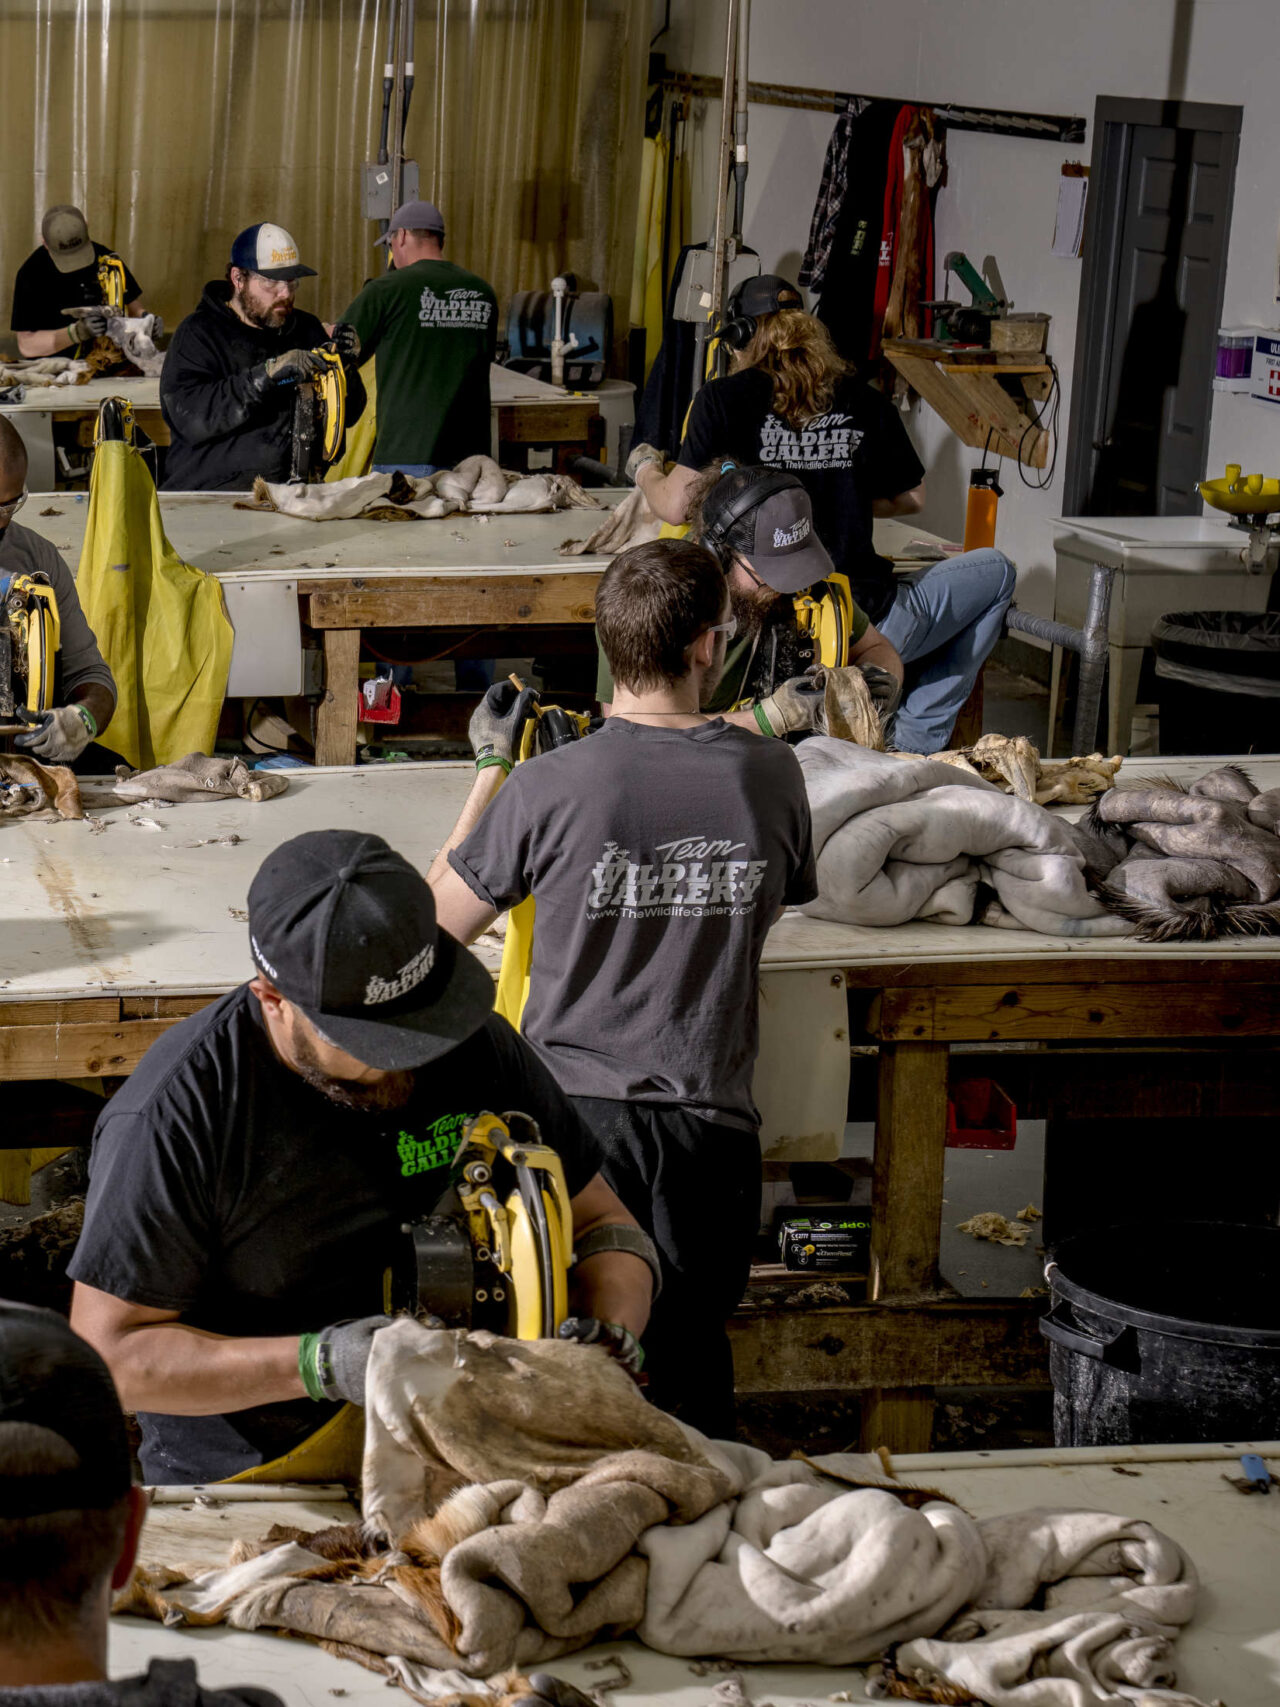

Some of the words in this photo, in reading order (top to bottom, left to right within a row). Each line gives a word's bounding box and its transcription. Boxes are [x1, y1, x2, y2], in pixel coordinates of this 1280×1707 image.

[420, 296, 492, 312] WILDLIFE
[444, 288, 484, 300] Team
[418, 309, 490, 323] GALLERY
[800, 412, 853, 432] Team
[760, 428, 865, 447] WILDLIFE
[655, 836, 746, 863] Team
[592, 860, 768, 888] WILDLIFE
[587, 878, 763, 908] GALLERY
[366, 945, 434, 999] WILDLIFE
[397, 944, 431, 976] Team
[363, 957, 434, 1006] GALLERY
[426, 1113, 476, 1137] Team
